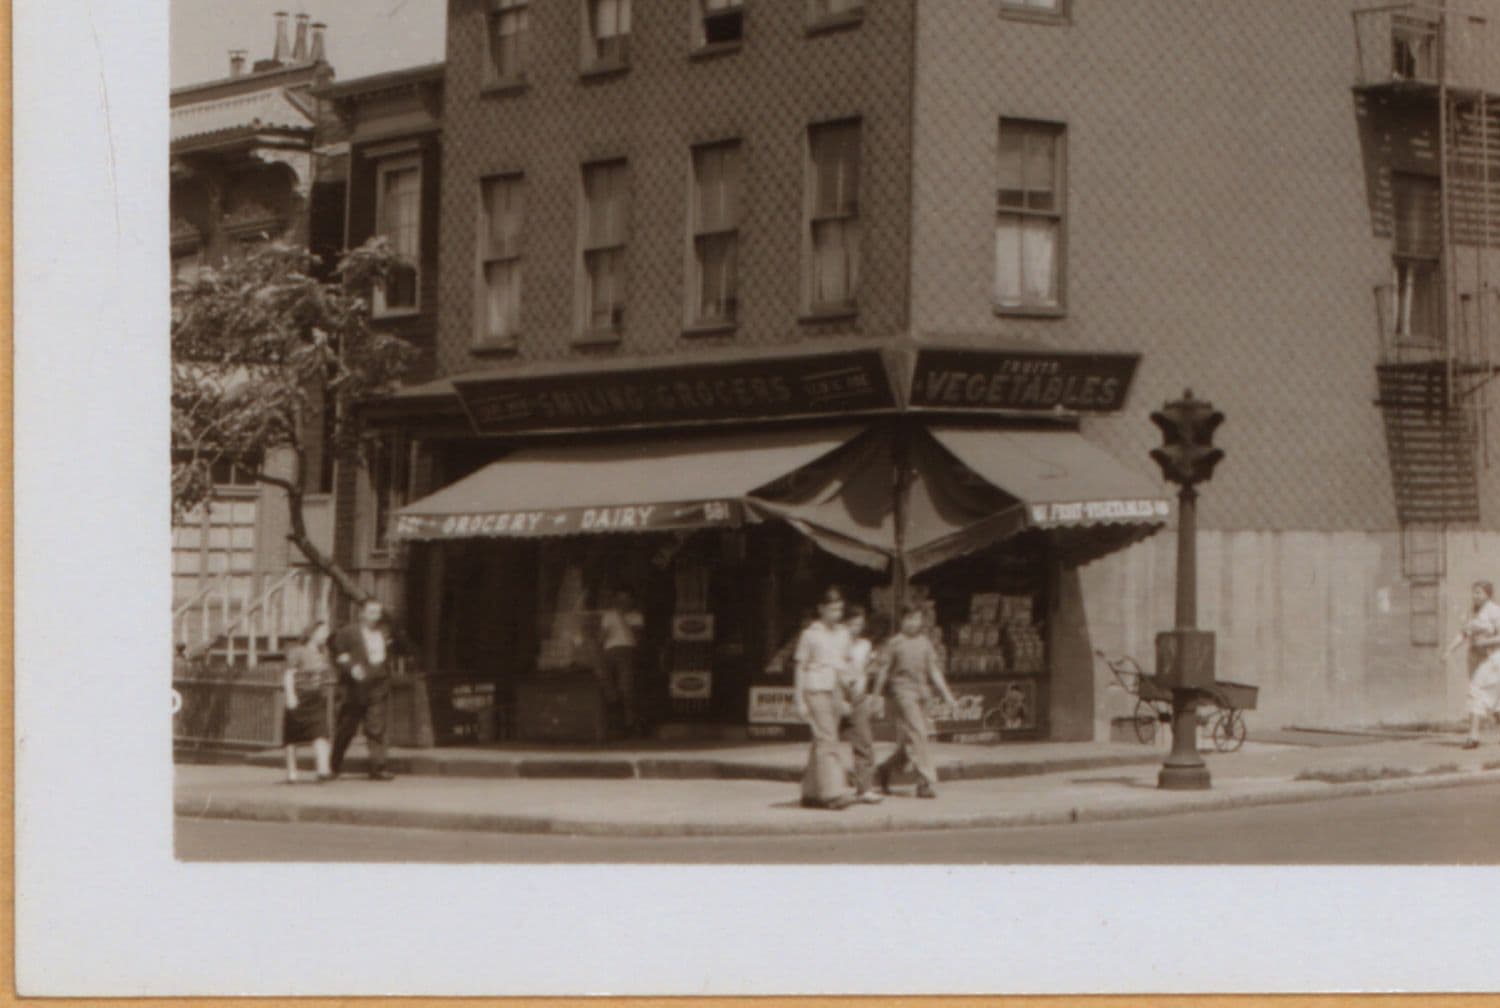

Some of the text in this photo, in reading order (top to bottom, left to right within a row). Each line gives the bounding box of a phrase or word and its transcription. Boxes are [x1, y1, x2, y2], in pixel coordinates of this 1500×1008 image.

[655, 376, 792, 409] GROCERS
[925, 371, 1118, 404] VEGETABLES
[443, 512, 544, 534] GROCERY
[581, 505, 656, 529] DAIRY
